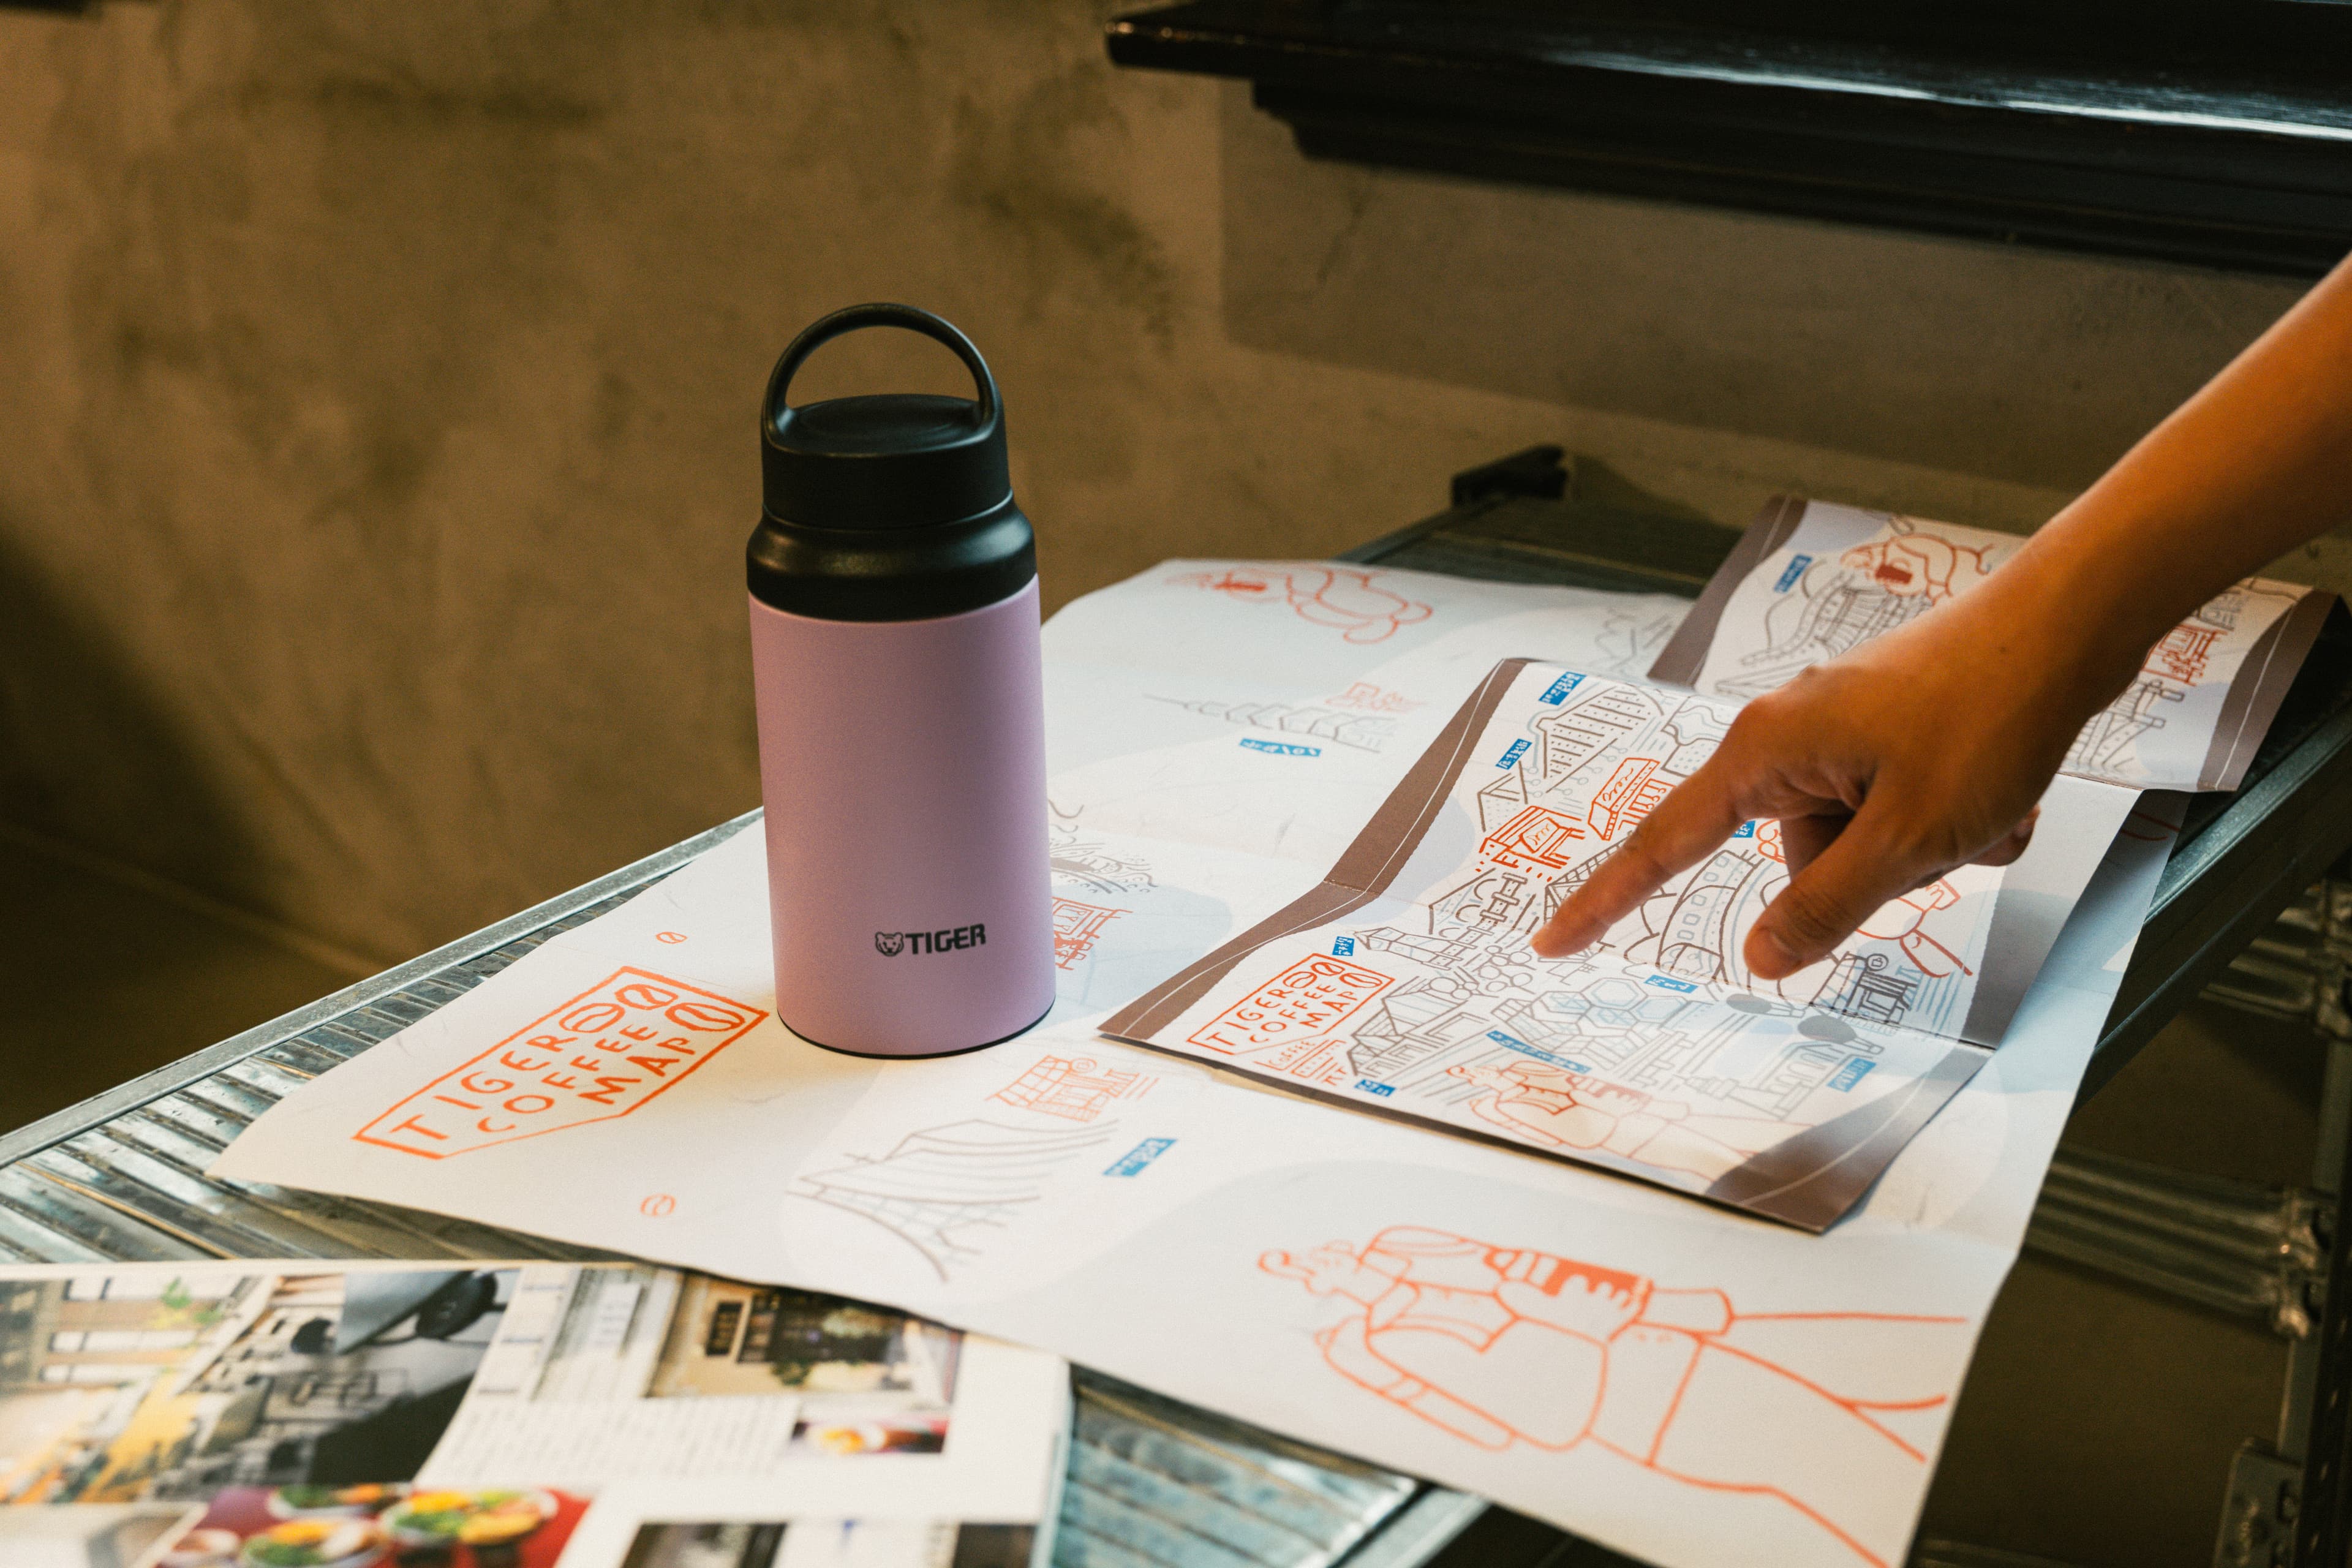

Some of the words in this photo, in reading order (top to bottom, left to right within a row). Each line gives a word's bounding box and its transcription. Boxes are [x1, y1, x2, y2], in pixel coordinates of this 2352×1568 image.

[905, 923, 986, 954] TIGER
[1205, 989, 1294, 1047] TIGER
[1250, 985, 1336, 1043] COFFEE
[1299, 991, 1358, 1028] MAP
[389, 1035, 579, 1141] TIGER
[476, 1025, 660, 1134] COFFEE
[576, 1037, 709, 1106] MAP
